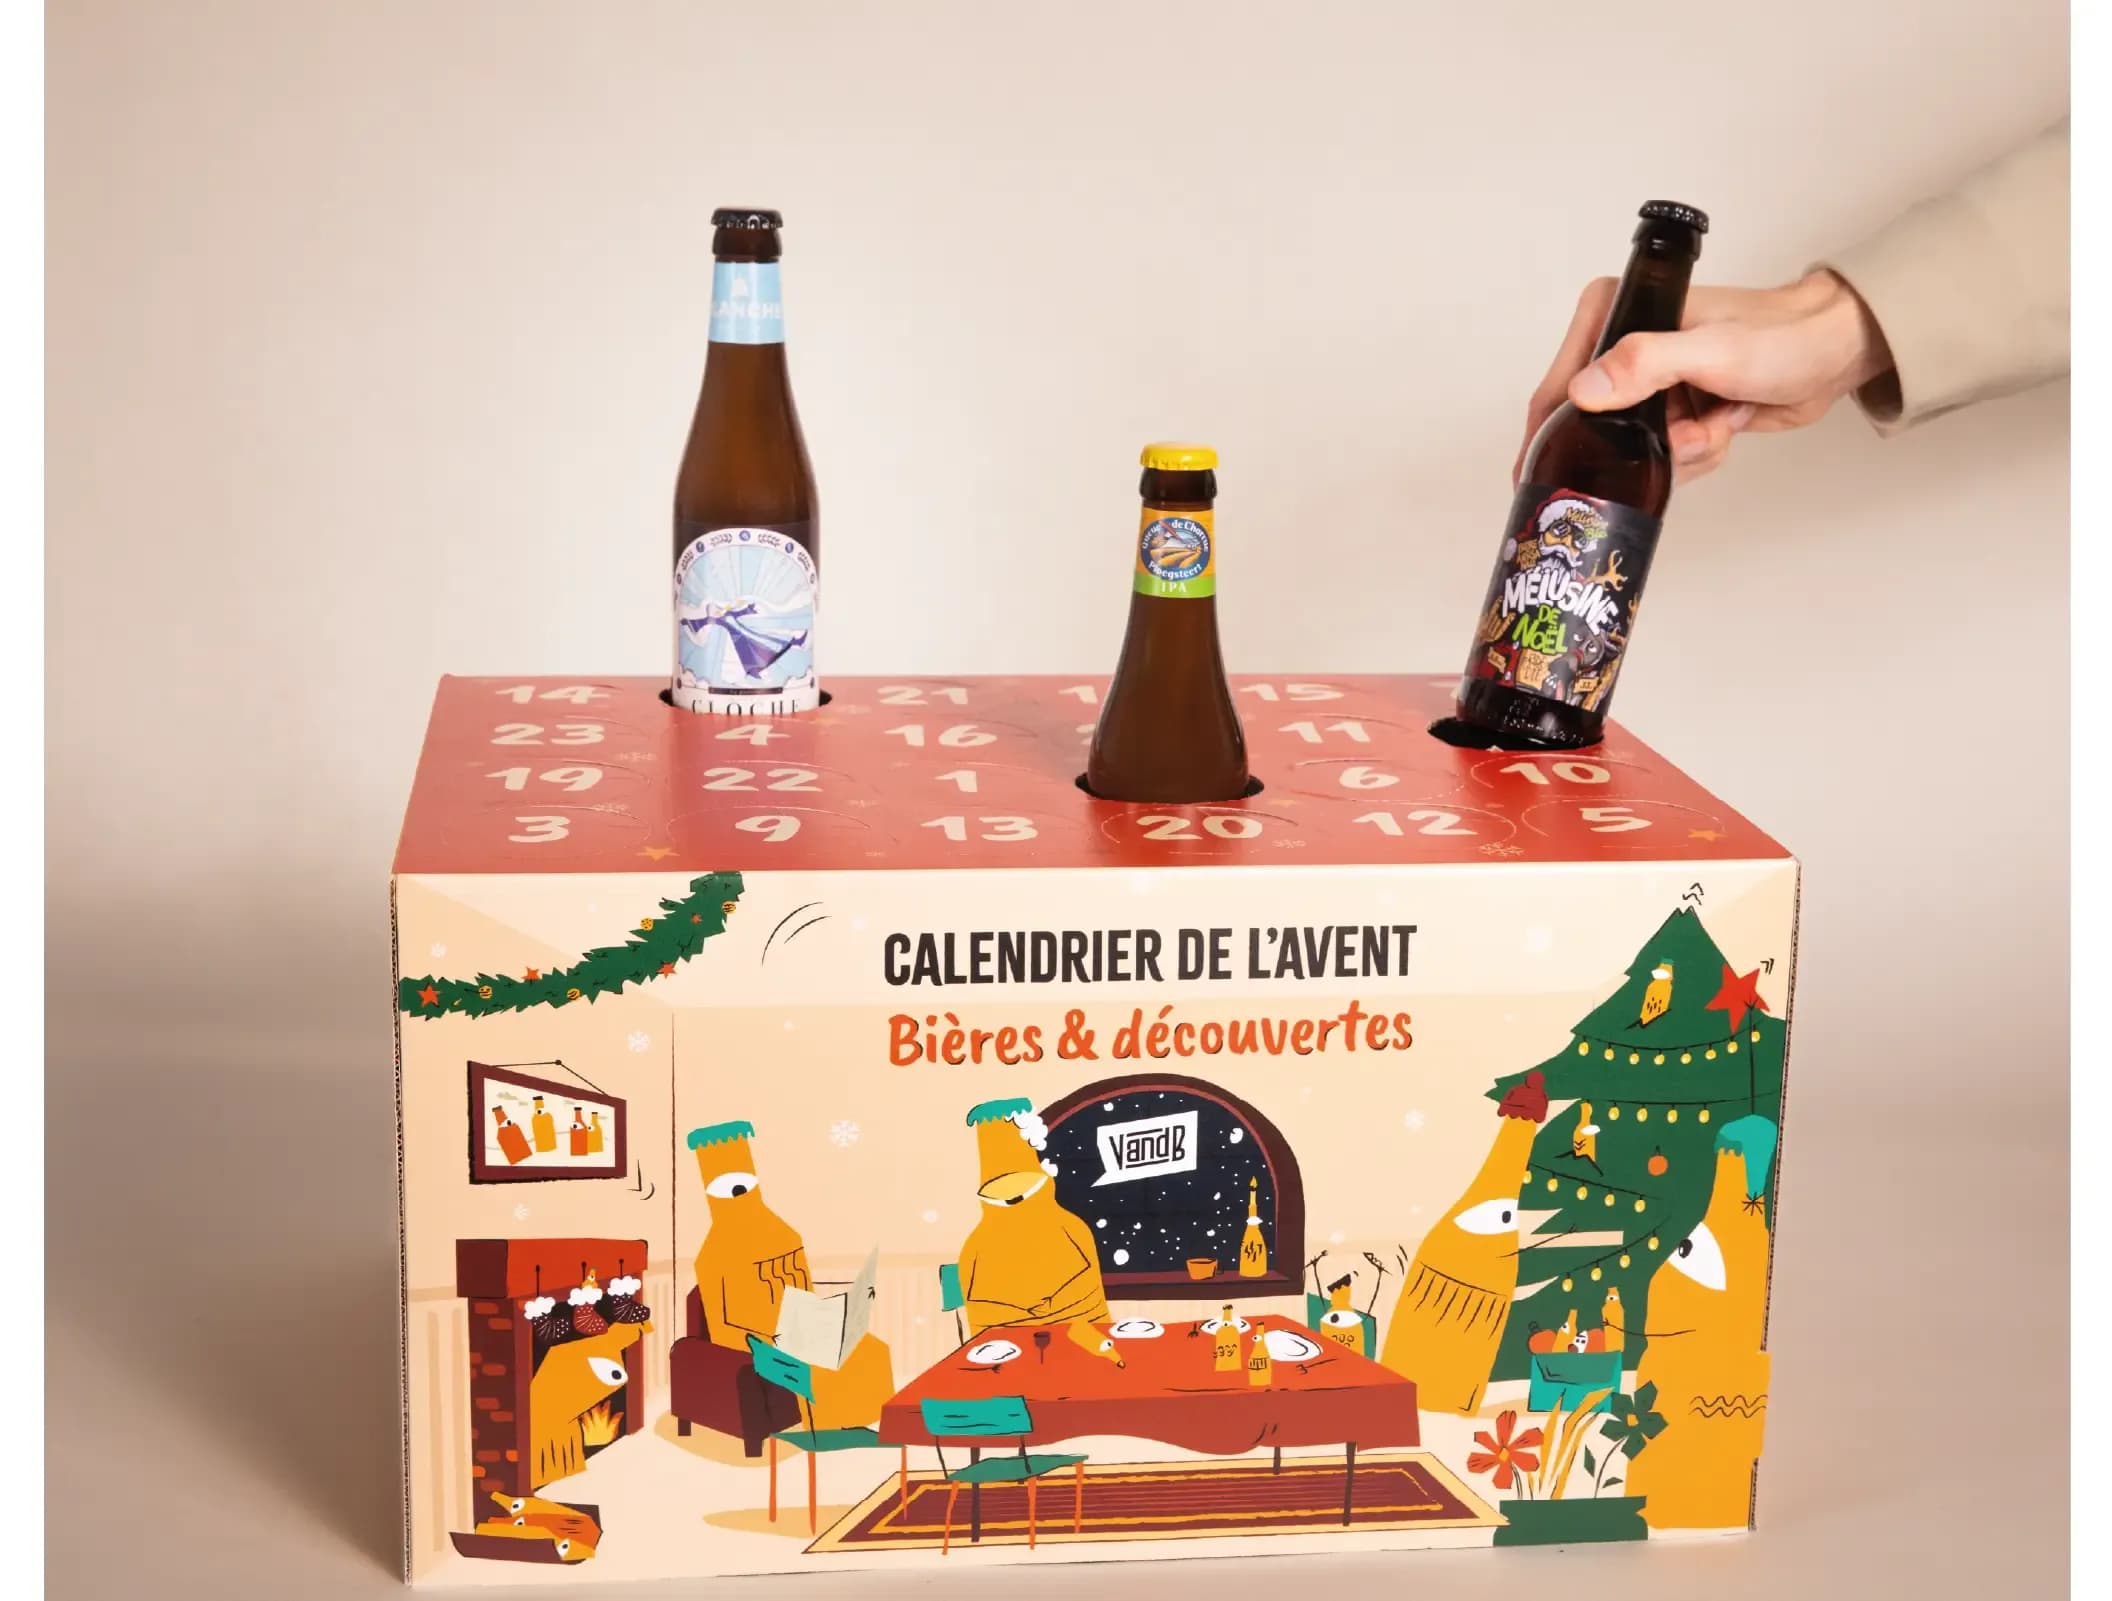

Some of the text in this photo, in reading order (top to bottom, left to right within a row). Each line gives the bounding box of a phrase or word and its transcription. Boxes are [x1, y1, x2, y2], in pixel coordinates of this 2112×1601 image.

[1171, 519, 1184, 529] de
[1161, 582, 1188, 593] IPA
[1502, 566, 1619, 634] MÉLUSINE
[1537, 604, 1562, 624] DE
[499, 685, 606, 704] 14
[877, 686, 967, 704] 21
[1057, 685, 1098, 704] 1
[1240, 683, 1345, 701] 15
[491, 723, 605, 745] 23
[715, 722, 789, 746] 4
[884, 724, 997, 747] 16
[1278, 722, 1371, 743] 11
[485, 767, 603, 791] 19
[703, 767, 823, 792] 22
[936, 770, 978, 793] 1
[1339, 766, 1400, 789] 6
[1500, 761, 1611, 785] 10
[508, 815, 571, 843] 3
[735, 815, 801, 842] 9
[920, 816, 1038, 842] 13
[1136, 815, 1264, 841] 20
[1353, 810, 1476, 836] 12
[1580, 806, 1653, 833] 5
[884, 925, 1417, 986] CALENDRIER DE L'AVENT
[888, 999, 1413, 1067] Bières & découvertes
